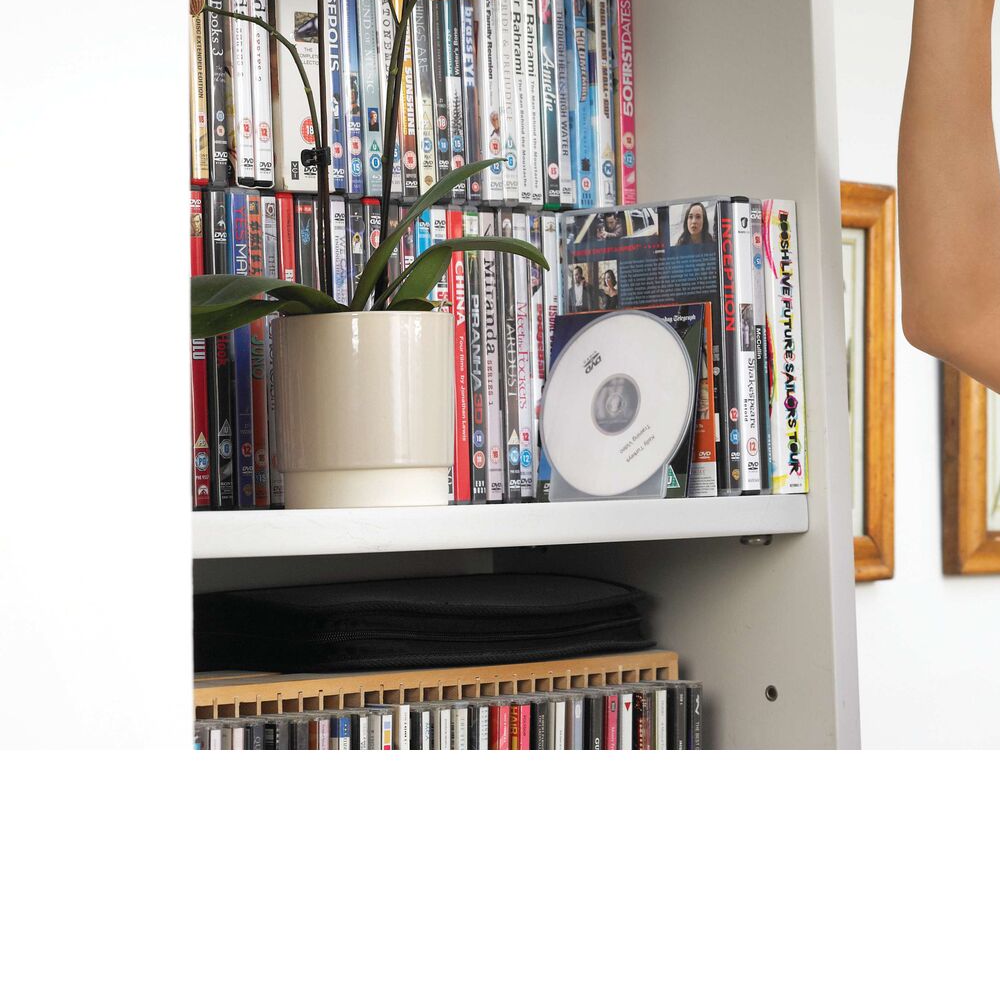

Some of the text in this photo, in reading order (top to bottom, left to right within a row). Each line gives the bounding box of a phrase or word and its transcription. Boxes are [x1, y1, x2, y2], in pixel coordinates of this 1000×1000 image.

[463, 7, 475, 88] brassEYE
[485, 9, 493, 40] Family
[556, 11, 566, 58] THROUGH
[196, 36, 204, 70] EXTENDED
[212, 49, 224, 57] 3
[365, 48, 374, 94] MUSIC
[417, 46, 428, 73] ARE
[558, 59, 567, 80] HELL
[405, 67, 415, 136] SUNSHINE
[503, 53, 514, 121] PREJUDICE
[542, 46, 557, 112] Amelie
[560, 93, 568, 117] HIGH
[213, 151, 228, 160] DVD
[560, 120, 569, 156] WATER
[235, 206, 247, 241] YES
[455, 261, 465, 325] CHINA
[721, 217, 736, 331] INCEPTION
[484, 258, 497, 355] Miranda
[516, 302, 528, 338] Meet
[783, 299, 794, 359] FUTURE
[217, 333, 228, 367] Hook
[250, 336, 265, 380] JUNO
[471, 294, 483, 425] PIRANHA 3D
[459, 375, 465, 384] by
[517, 351, 529, 409] Fockers
[748, 357, 757, 429] Shakespeare
[784, 362, 798, 428] SAILORS
[788, 430, 802, 477] TOUR
[510, 706, 518, 735] HAIR
